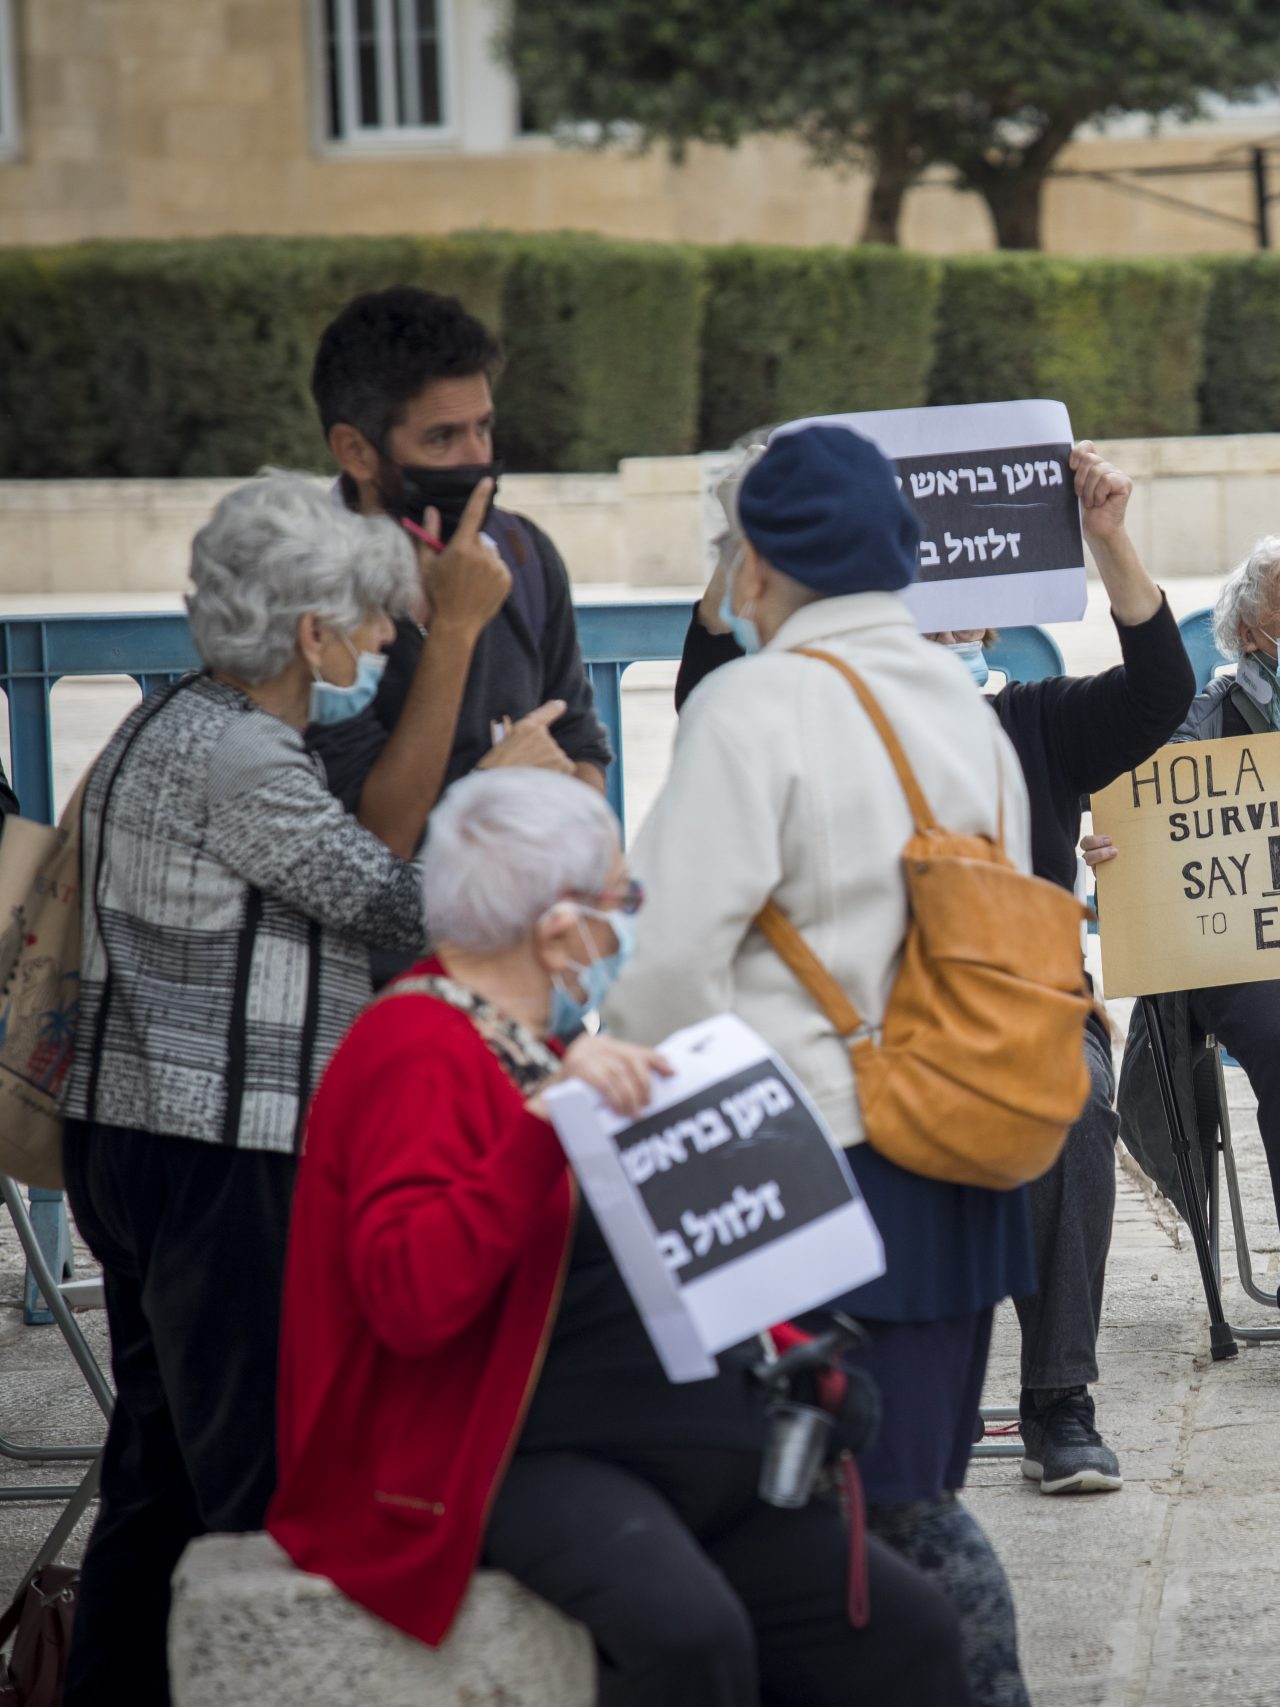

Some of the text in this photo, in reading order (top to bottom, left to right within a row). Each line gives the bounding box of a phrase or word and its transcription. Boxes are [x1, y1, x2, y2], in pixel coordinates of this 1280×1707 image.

[909, 466, 998, 499] בראש
[1001, 459, 1064, 495] גזען
[943, 527, 1021, 564] זלזול
[1182, 853, 1251, 899] SAY
[1197, 911, 1228, 935] TO
